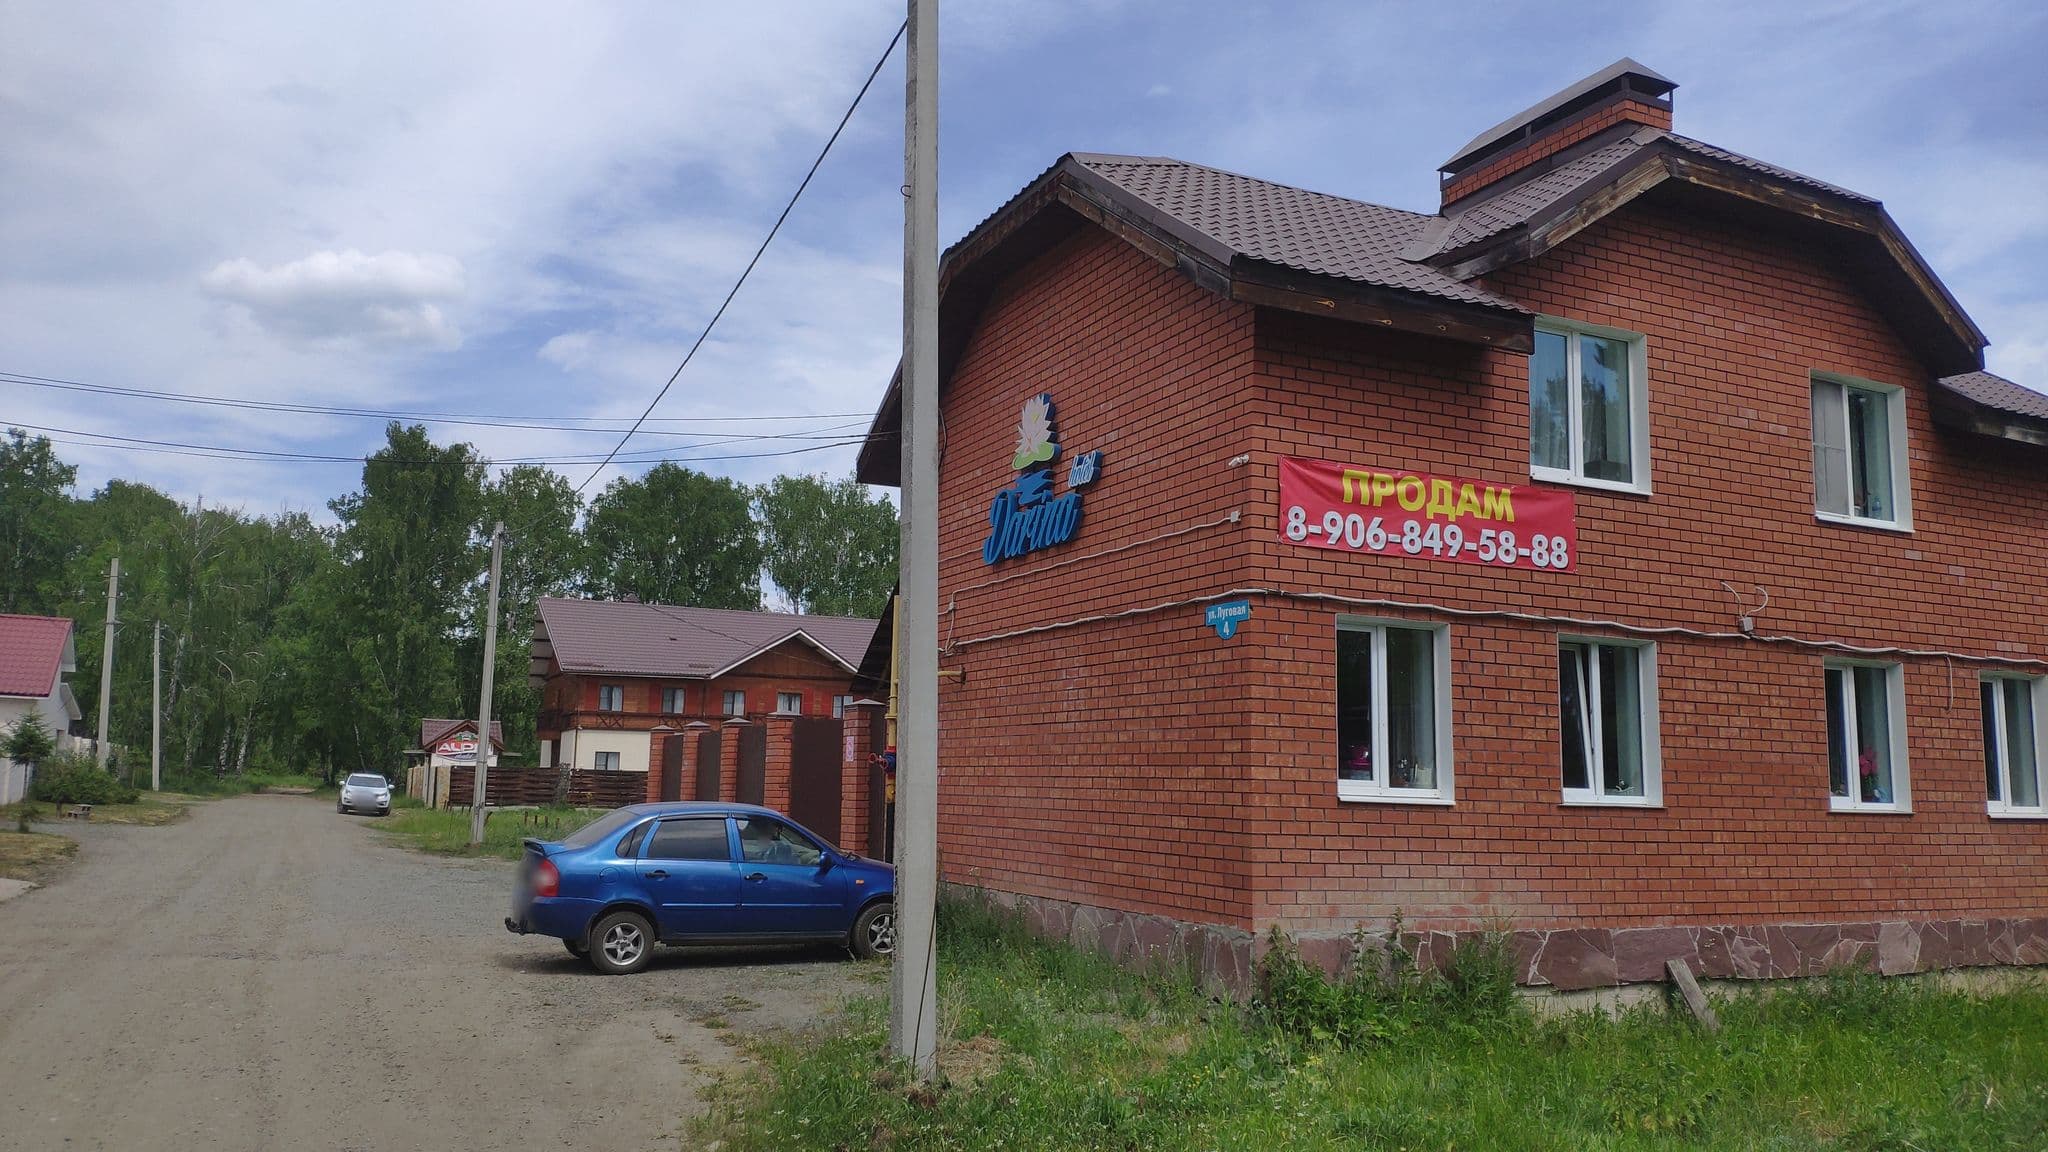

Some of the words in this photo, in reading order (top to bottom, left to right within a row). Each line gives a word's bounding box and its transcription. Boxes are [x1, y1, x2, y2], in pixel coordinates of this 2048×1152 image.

[1068, 449, 1098, 489] hotel
[1341, 468, 1515, 522] ПРОДАМ
[1286, 505, 1569, 569] 8-906-849-58-88
[1223, 621, 1230, 636] 4
